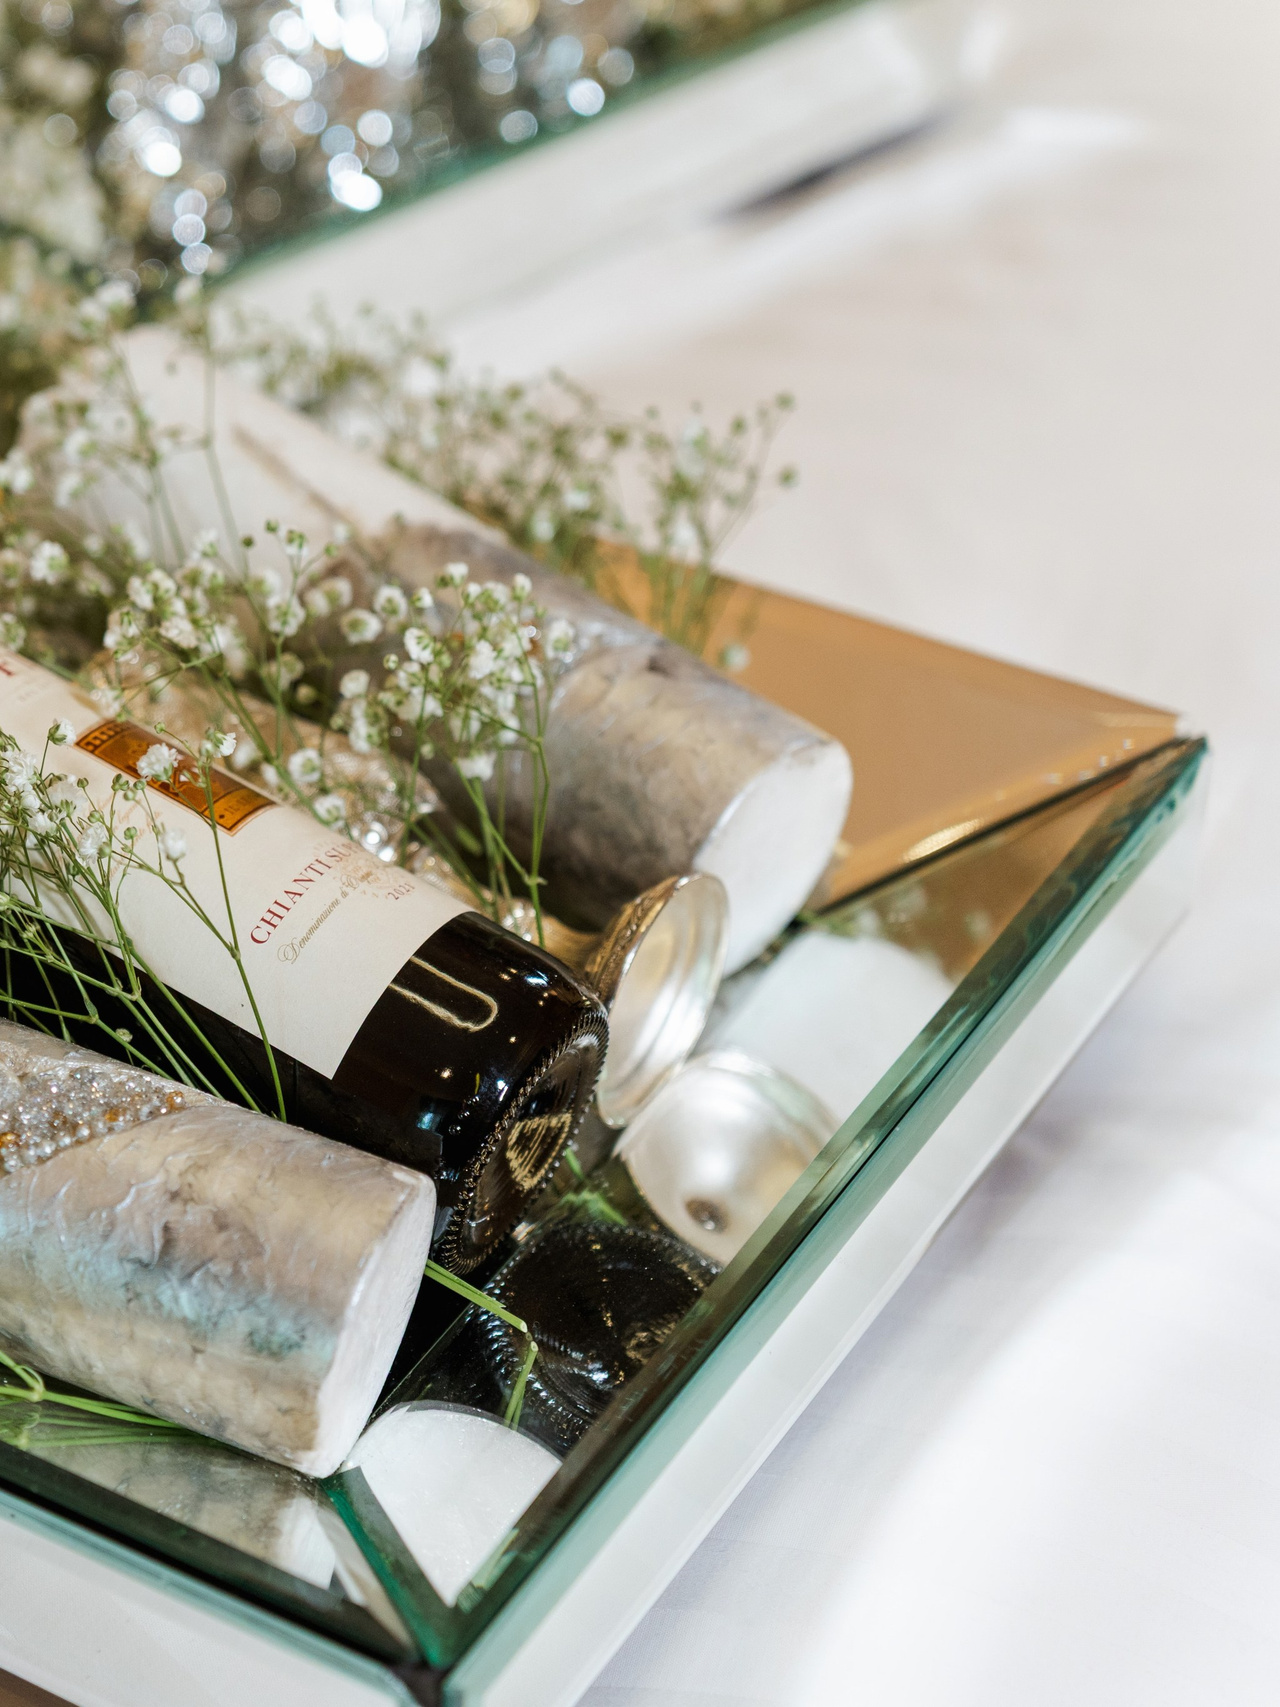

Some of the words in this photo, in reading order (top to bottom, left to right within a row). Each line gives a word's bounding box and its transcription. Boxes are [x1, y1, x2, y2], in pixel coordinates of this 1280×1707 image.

[250, 858, 332, 945] CHIANTI
[325, 842, 358, 863] SUP
[387, 882, 416, 901] 2021
[277, 897, 342, 965] Denominazione
